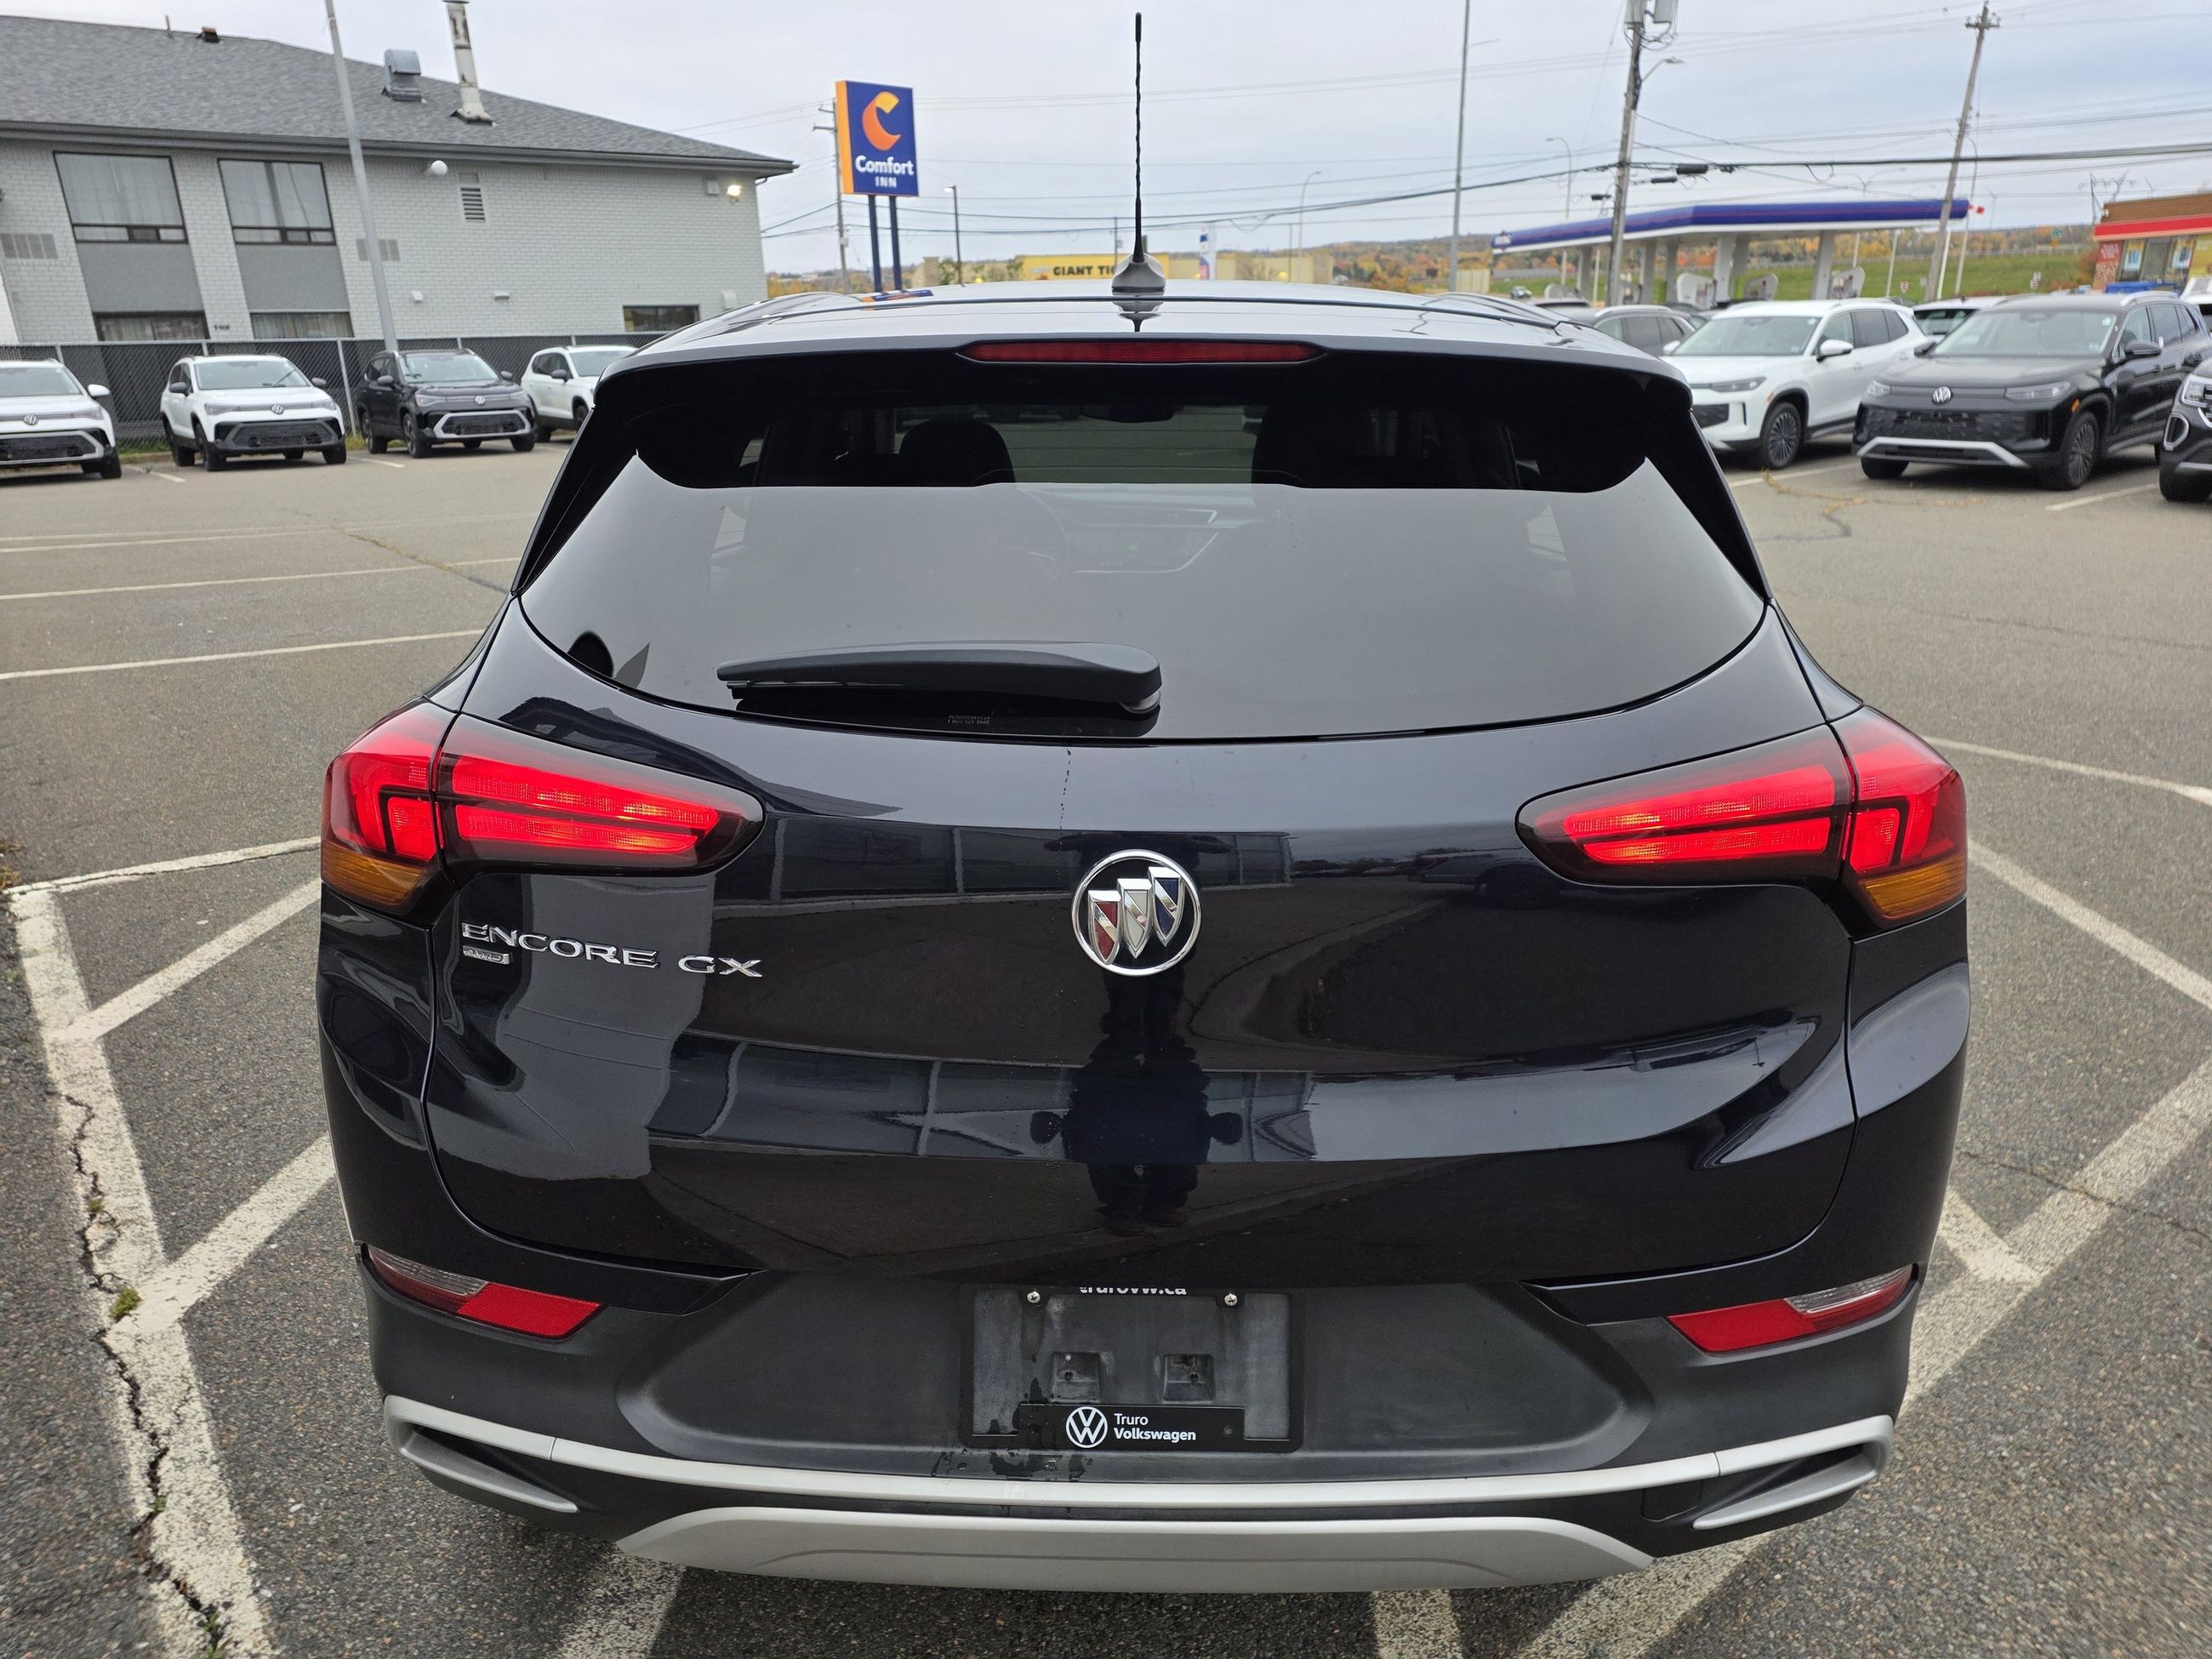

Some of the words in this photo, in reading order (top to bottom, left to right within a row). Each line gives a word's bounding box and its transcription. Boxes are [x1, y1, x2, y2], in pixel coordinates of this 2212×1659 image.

[854, 155, 915, 175] Comfort
[875, 175, 898, 188] INN
[1053, 265, 1093, 276] GIANT
[461, 921, 660, 969] ENCORE
[677, 954, 763, 978] GX
[1113, 1412, 1149, 1426] Truro
[1113, 1427, 1197, 1444] Volkswagen
